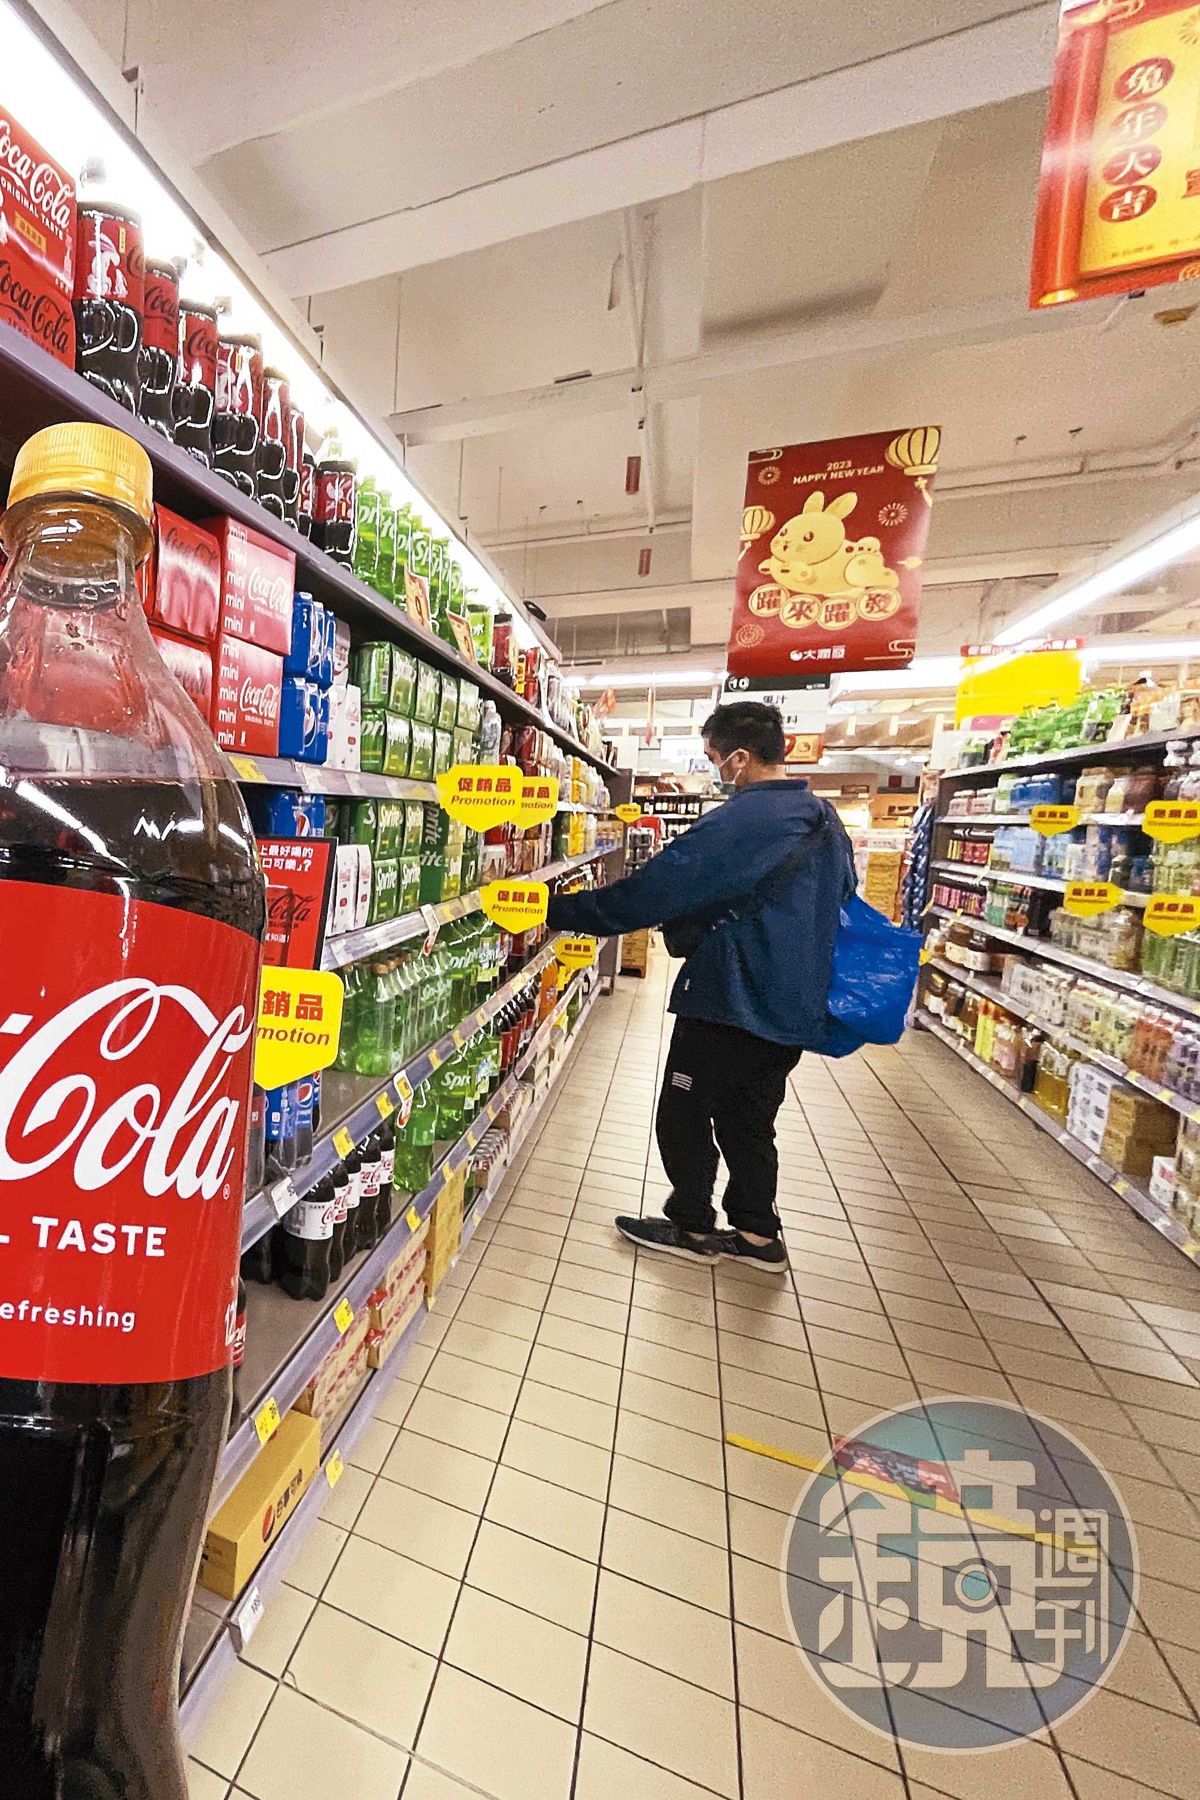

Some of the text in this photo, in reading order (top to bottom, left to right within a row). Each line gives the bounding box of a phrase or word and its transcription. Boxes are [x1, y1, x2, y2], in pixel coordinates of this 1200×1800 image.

[0, 176, 39, 218] ORIGINAL
[40, 213, 64, 241] TASTE
[826, 460, 852, 471] 2023
[793, 465, 884, 485] HAPPY NEW YEAR
[227, 570, 246, 588] mini
[248, 566, 290, 614] Coca-Cola
[225, 592, 244, 611] mini
[224, 615, 243, 634] mini
[221, 664, 239, 681] mini
[219, 686, 238, 702] mini
[240, 677, 279, 719] Coca-Cola
[218, 708, 236, 724] mini
[217, 729, 235, 746] mini
[458, 777, 511, 793] 促銷品
[522, 786, 549, 798] 銷品
[451, 795, 515, 806] Promotion
[260, 845, 314, 858] 上最好喝的
[492, 904, 543, 915] Promotion
[261, 990, 324, 1022] 銷品
[257, 1027, 330, 1046] motion
[32, 1216, 168, 1257] TASTE
